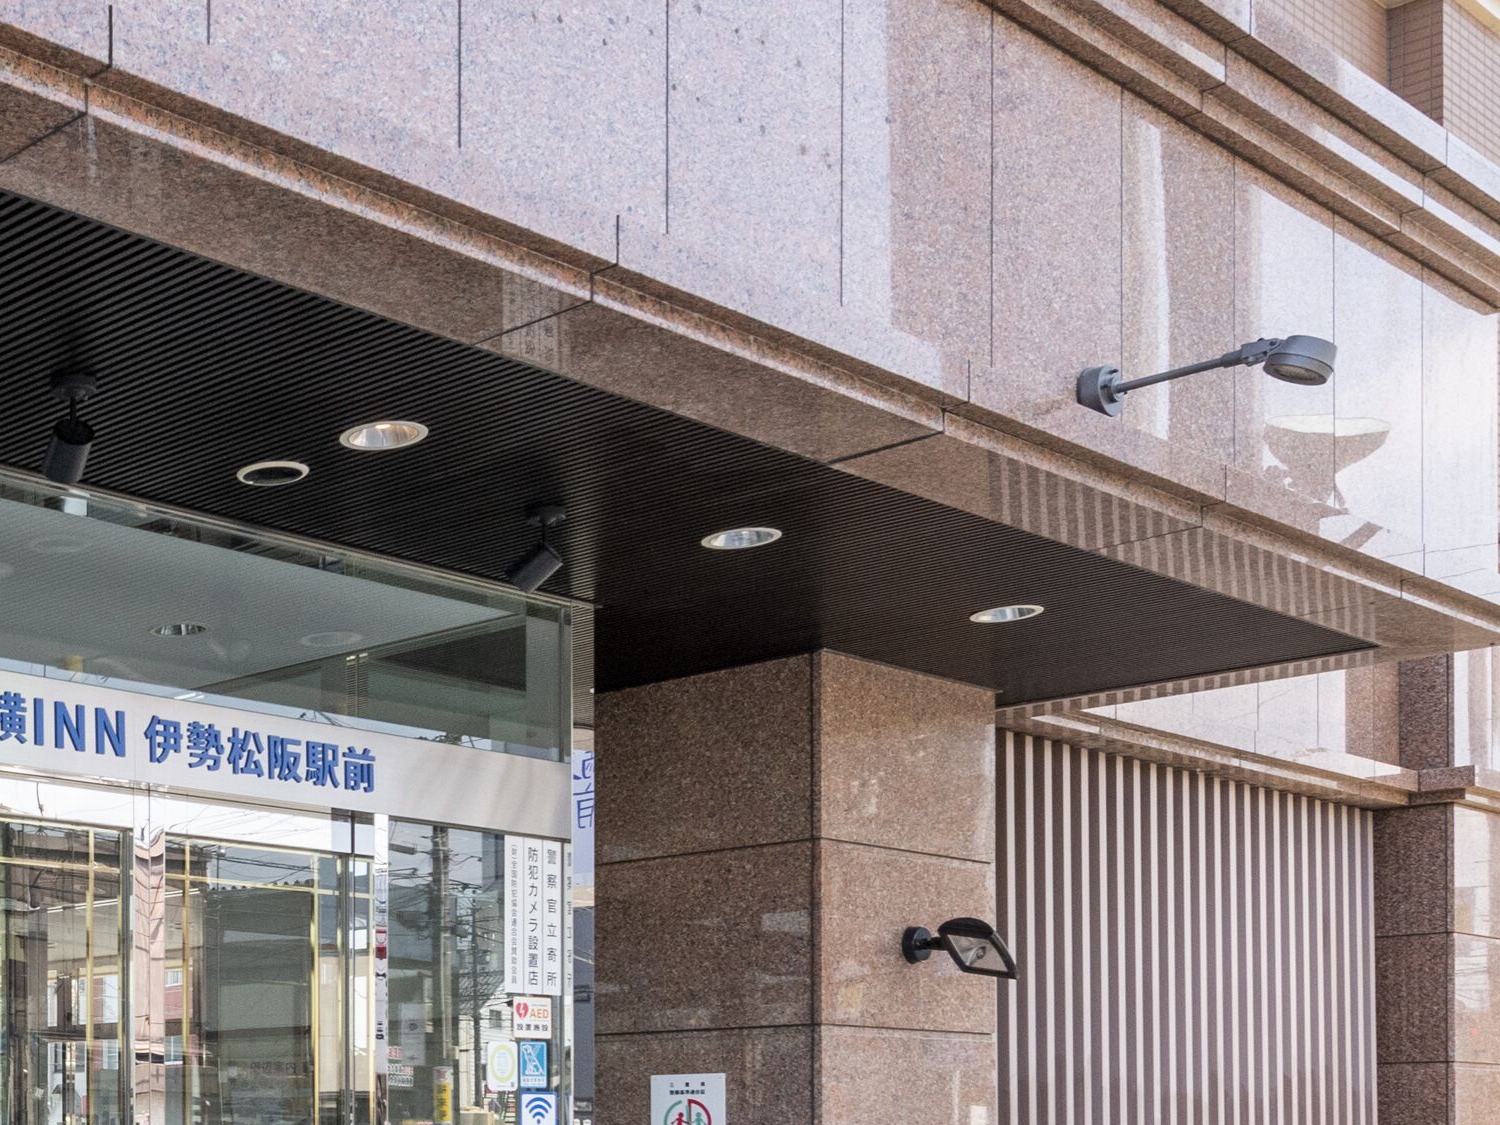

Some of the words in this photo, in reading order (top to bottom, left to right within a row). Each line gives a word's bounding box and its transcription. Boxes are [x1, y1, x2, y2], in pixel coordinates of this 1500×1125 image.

[144, 714, 377, 794] 伊勢松阪駅前
[528, 847, 539, 986] 防犯カメラ設置店
[547, 849, 557, 986] 警察官立寄所
[530, 1008, 549, 1019] AED
